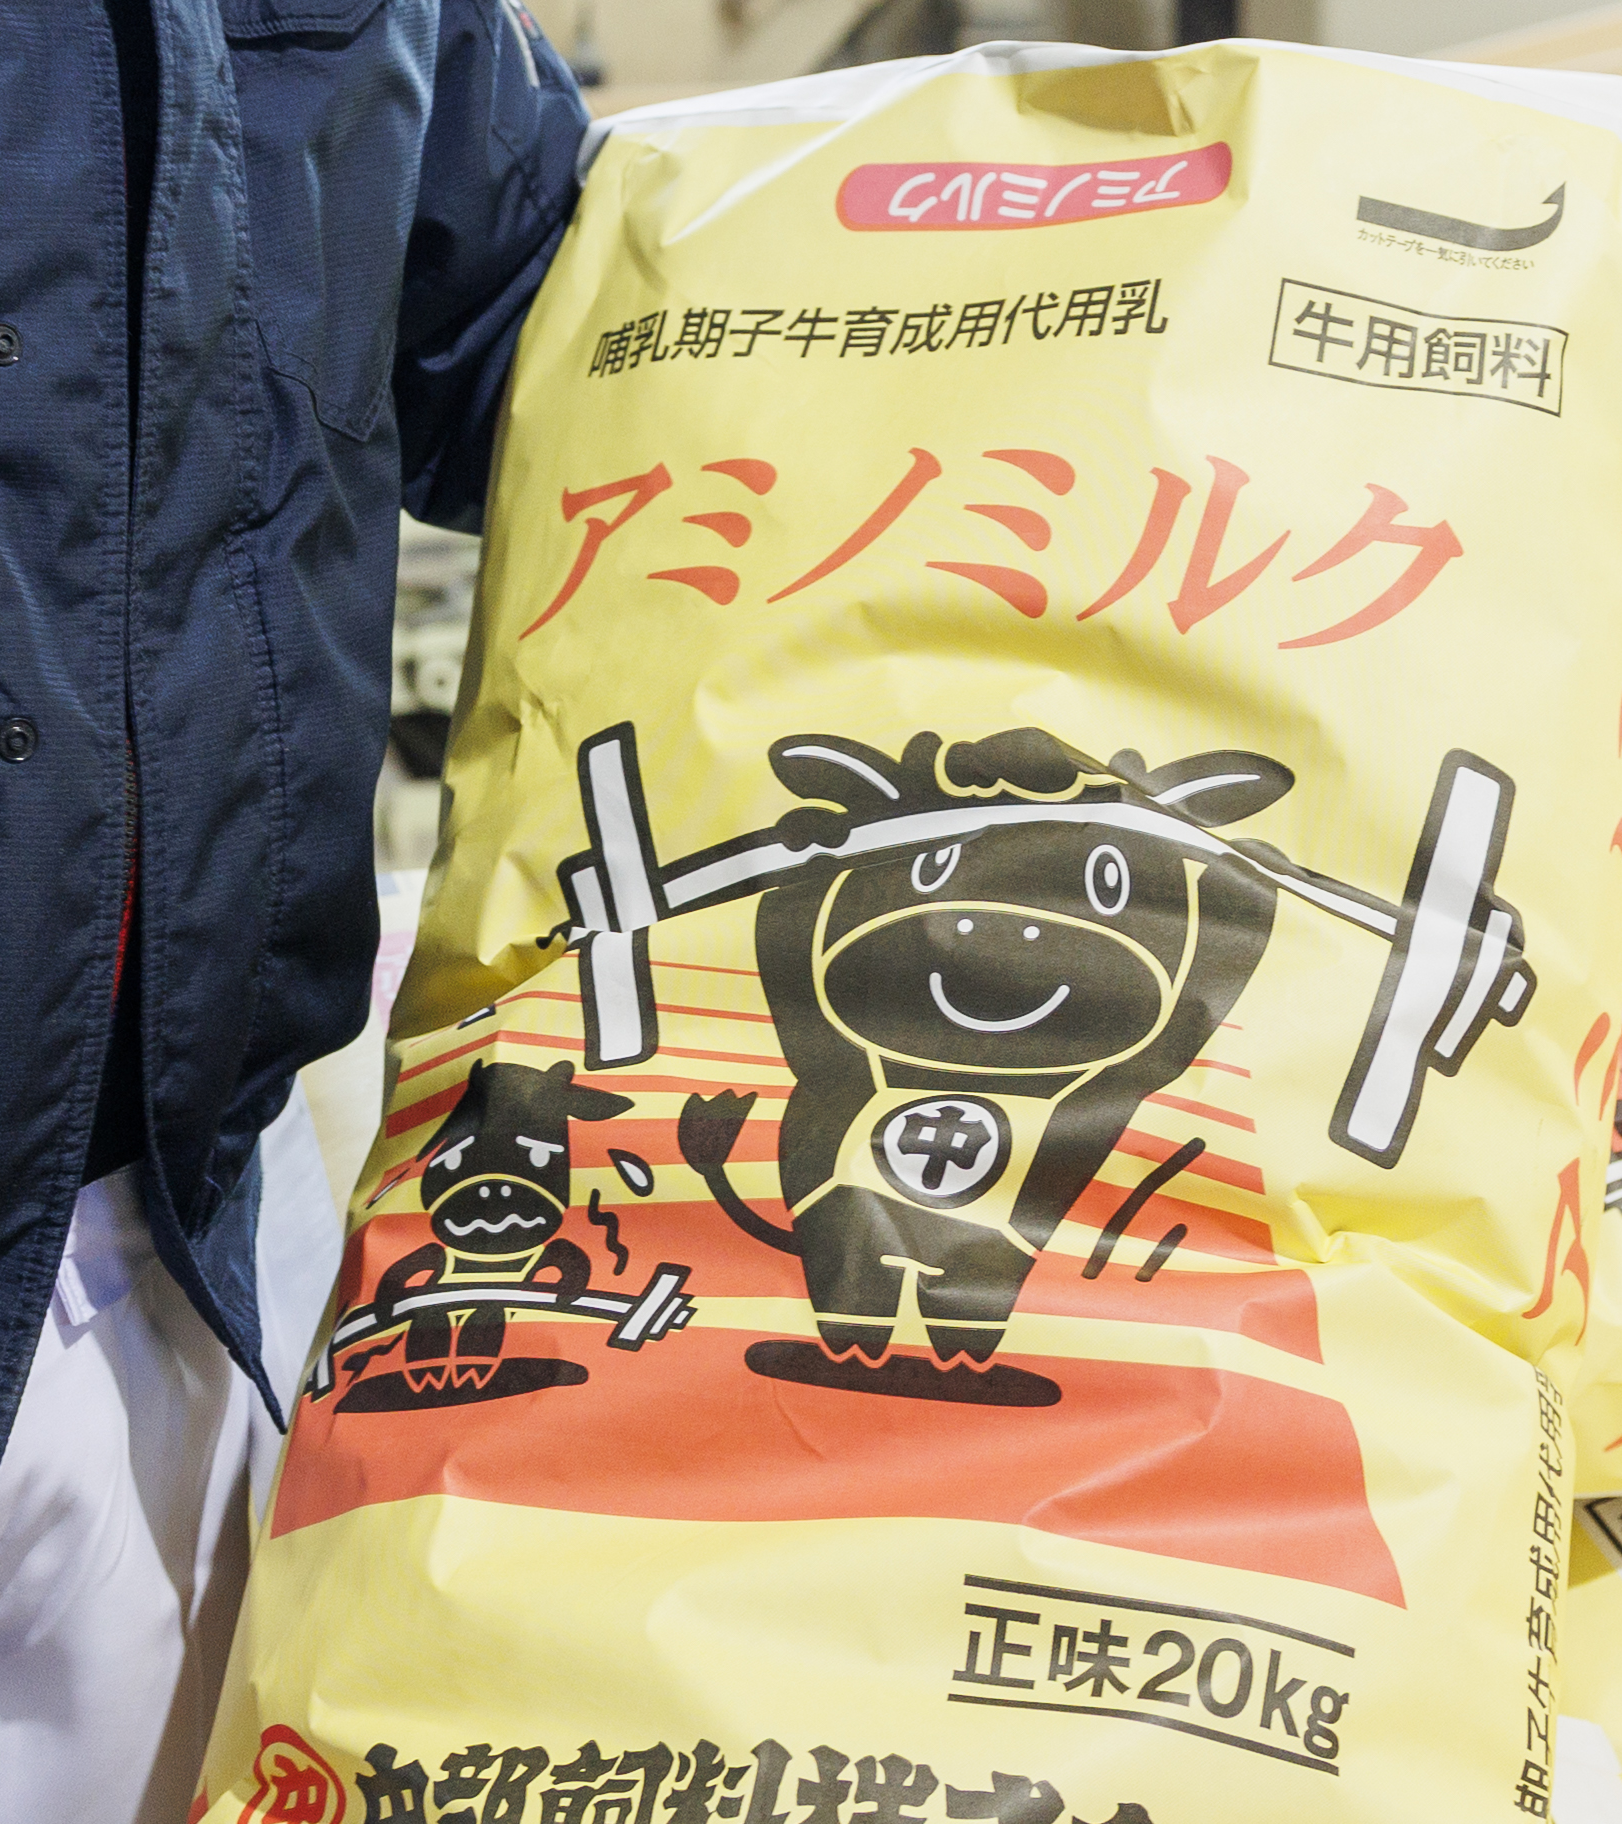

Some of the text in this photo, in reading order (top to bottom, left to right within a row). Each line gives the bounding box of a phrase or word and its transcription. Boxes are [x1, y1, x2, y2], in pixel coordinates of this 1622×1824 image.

[888, 159, 1188, 222] アミノミルク
[1356, 228, 1535, 271] カットテープを一気に引いてください
[588, 279, 1169, 379] 哺乳期子牛育成用代用乳
[1293, 299, 1553, 398] 牛用飼料
[517, 446, 1464, 650] アミノミルク
[952, 1602, 1349, 1760] 正味20kg
